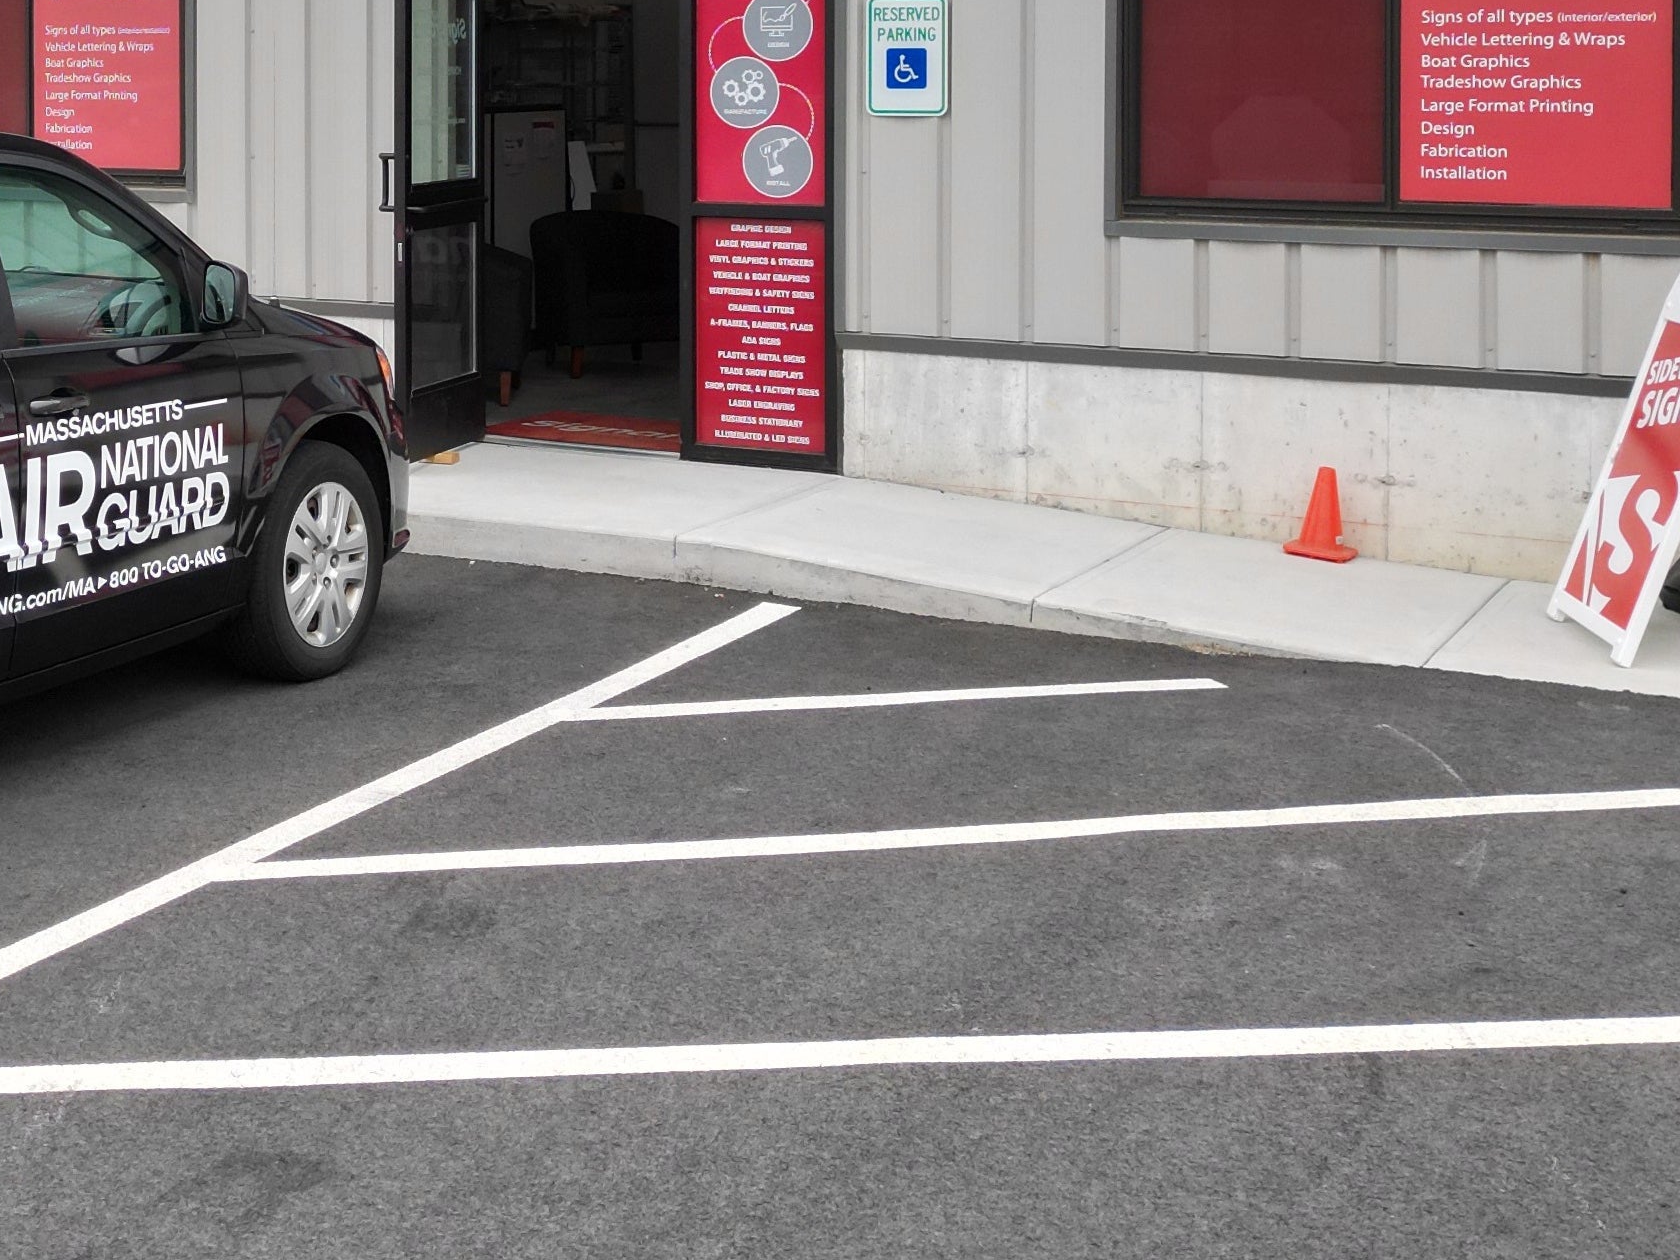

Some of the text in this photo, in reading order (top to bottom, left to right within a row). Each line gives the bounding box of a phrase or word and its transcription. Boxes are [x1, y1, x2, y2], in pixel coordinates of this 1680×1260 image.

[873, 6, 940, 21] RESERVED
[1421, 10, 1463, 26] Signs
[1467, 9, 1485, 23] of
[1487, 9, 1505, 23] all
[1509, 10, 1553, 26] types
[45, 24, 68, 37] Signs
[70, 24, 79, 34] of
[80, 24, 91, 34] all
[92, 25, 116, 37] types
[877, 27, 936, 41] PARKING
[45, 41, 154, 54] Vehicle Lettering & Wraps
[1421, 32, 1626, 49] Vehicle Lettering & Wraps
[45, 58, 104, 69] Boat Graphics
[1421, 54, 1530, 71] Boat Graphics
[45, 72, 132, 84] Tradeshow Graphics
[1421, 74, 1582, 92] Tradeshow Graphics
[45, 90, 138, 103] Large Format Printing
[45, 107, 75, 119] Design
[1421, 99, 1594, 116] Large Format Printing
[45, 123, 93, 133] Fabrication
[1421, 121, 1475, 138] Design
[50, 139, 93, 150] tallation
[1420, 144, 1508, 158] Fabrication
[1420, 166, 1507, 180] Installation
[1647, 356, 1680, 386] SIDE
[25, 398, 184, 447] MASSACHUSETTS
[100, 423, 229, 489] NATIONAL
[96, 471, 230, 551] GUARD
[109, 566, 139, 588] 800
[141, 545, 227, 580] TO-GO-ANG
